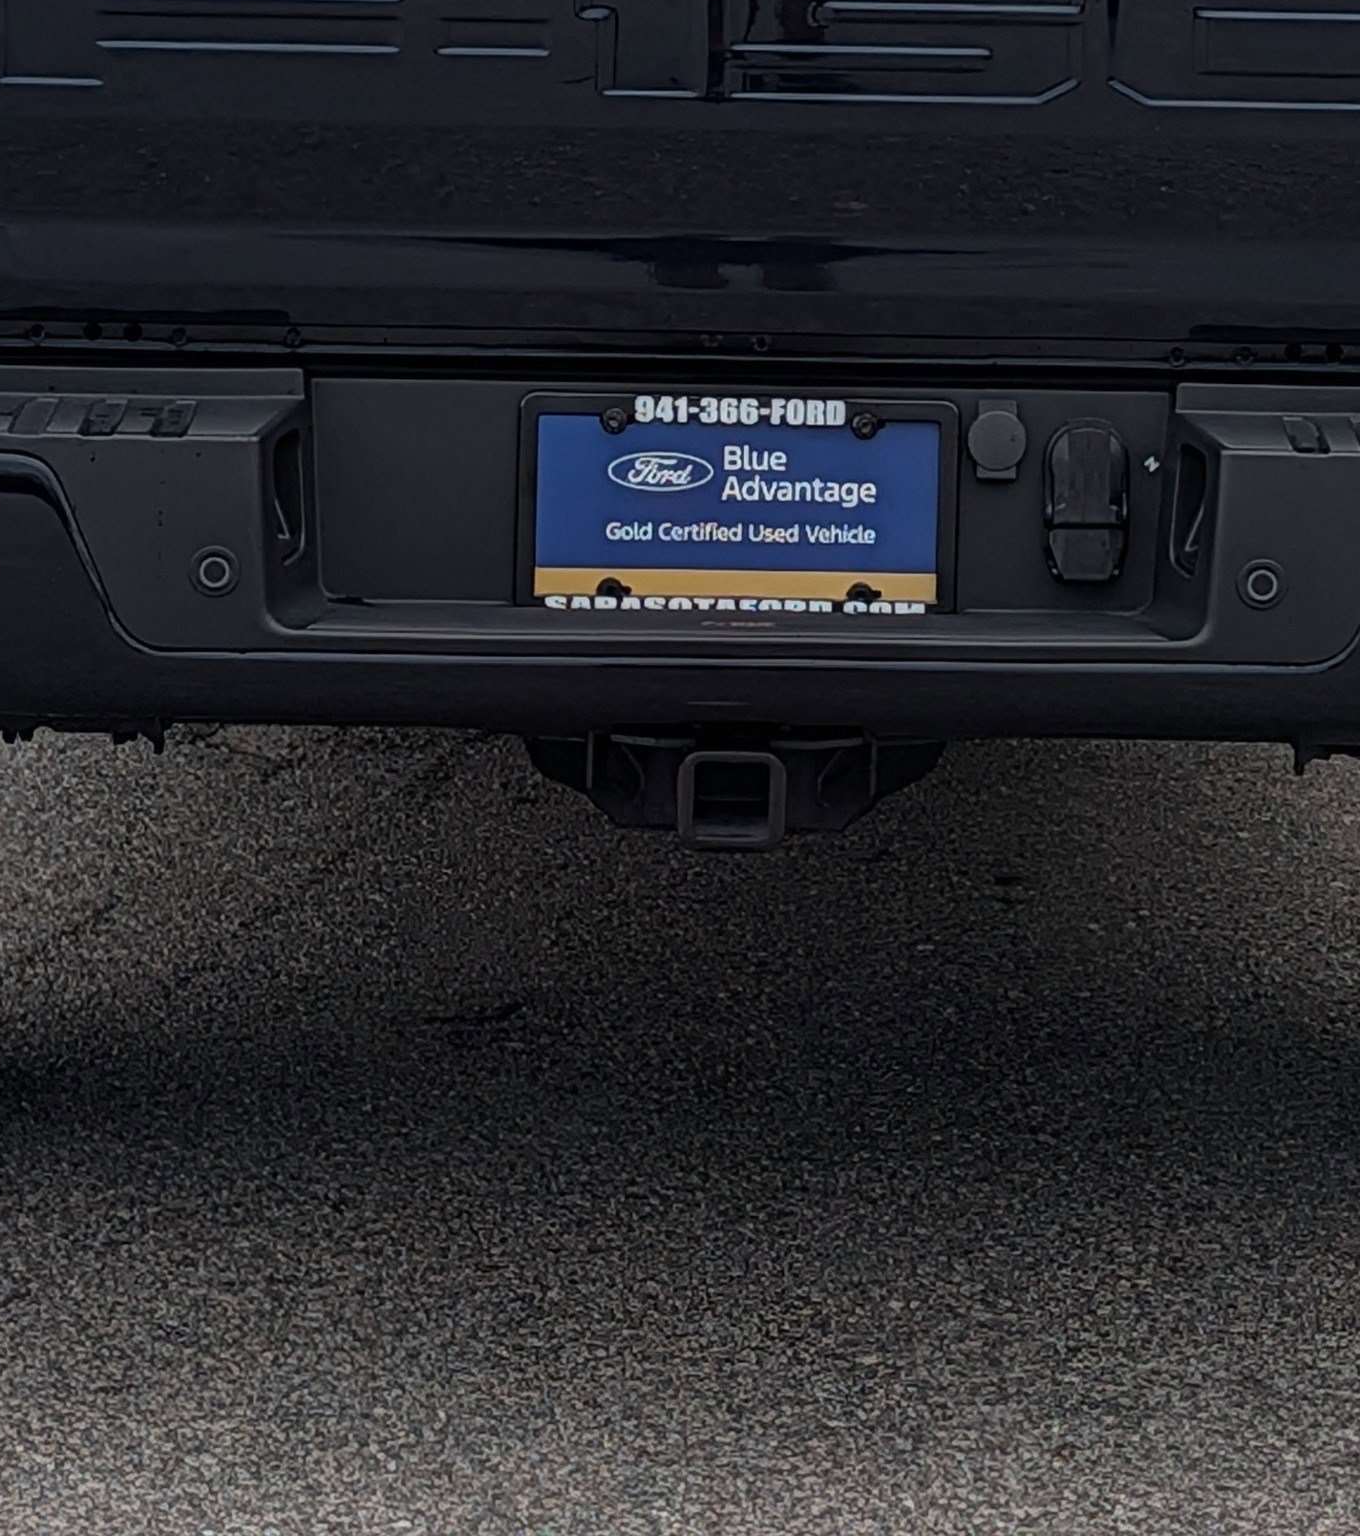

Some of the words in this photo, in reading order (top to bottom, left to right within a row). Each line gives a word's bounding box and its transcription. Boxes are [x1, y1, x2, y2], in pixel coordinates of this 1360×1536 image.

[634, 395, 846, 426] 941-366-FORD
[627, 456, 693, 485] Ford
[723, 444, 787, 471] Blue
[721, 474, 877, 508] Advantage
[605, 521, 653, 541] Gold
[658, 521, 742, 542] Certified
[748, 524, 799, 543] Used
[805, 524, 876, 544] Vehicle
